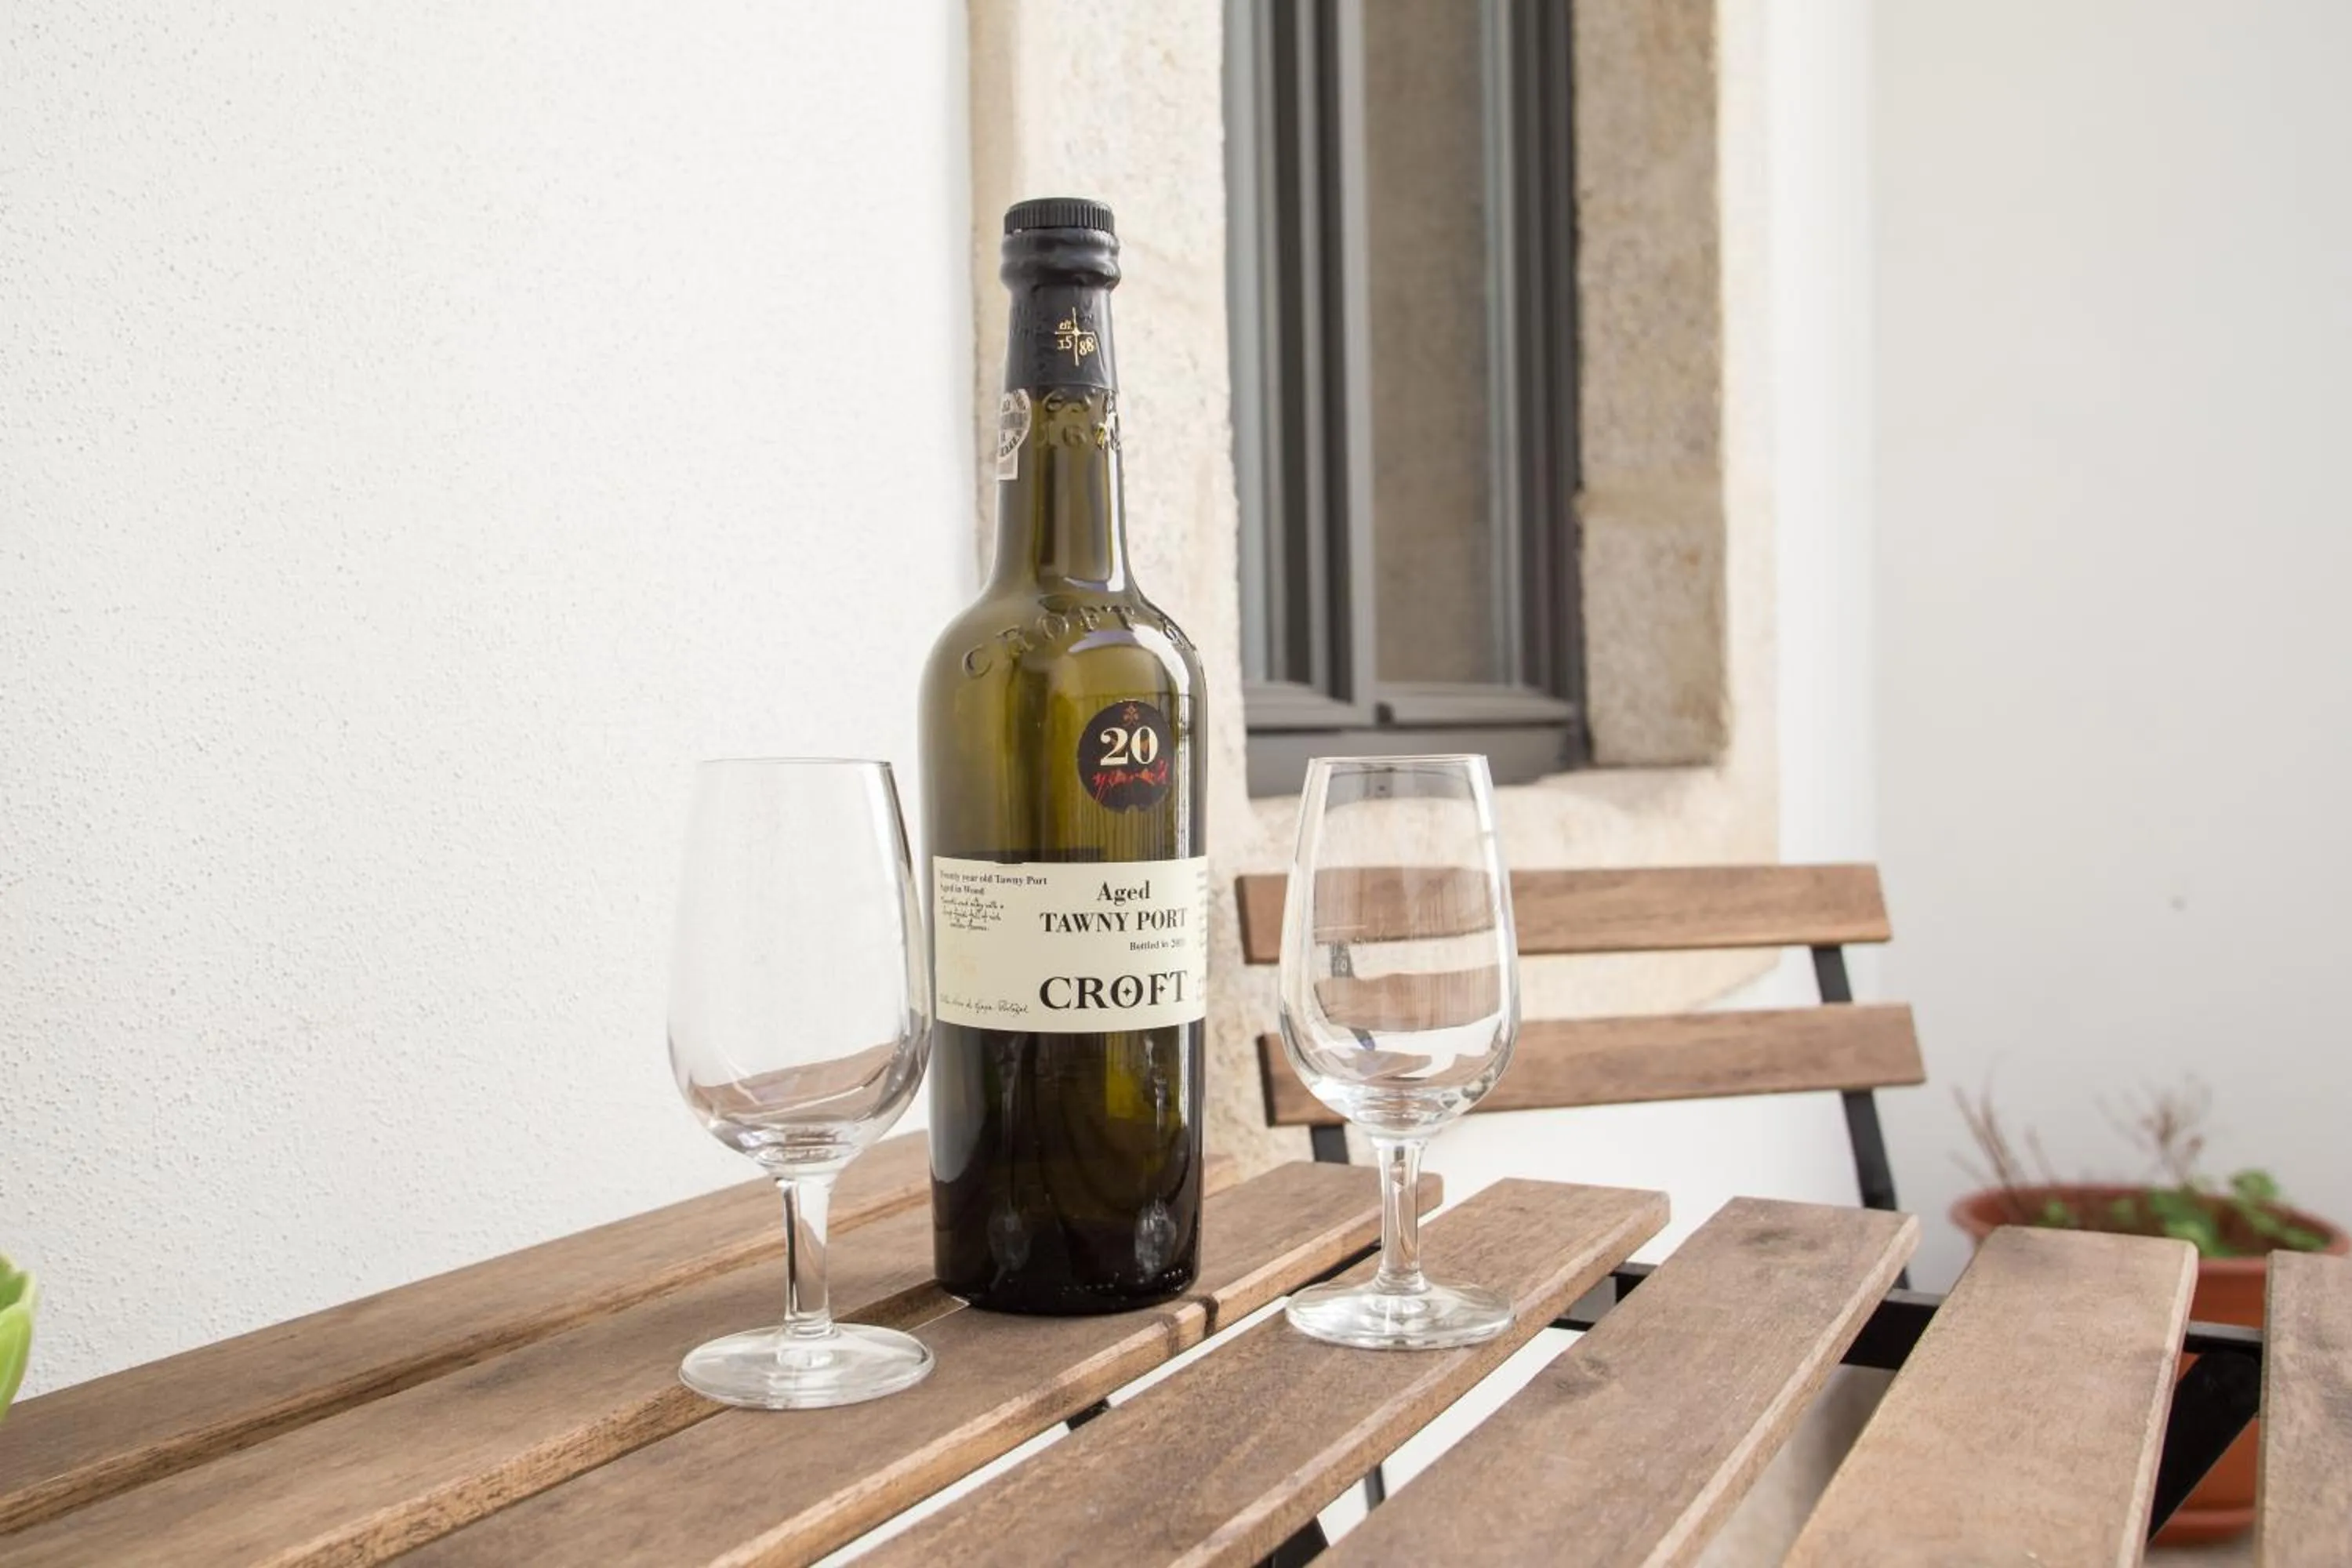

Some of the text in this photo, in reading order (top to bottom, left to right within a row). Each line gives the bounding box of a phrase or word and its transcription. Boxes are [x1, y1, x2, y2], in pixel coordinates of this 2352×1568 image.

[1080, 336, 1094, 355] 88
[1100, 725, 1158, 766] 20
[995, 874, 1023, 886] Tawny
[1026, 876, 1047, 885] Port
[1096, 880, 1150, 906] Aged
[1040, 908, 1188, 933] TAWNY PORT
[1130, 940, 1159, 951] Bottled
[1040, 971, 1188, 1010] CROFT
